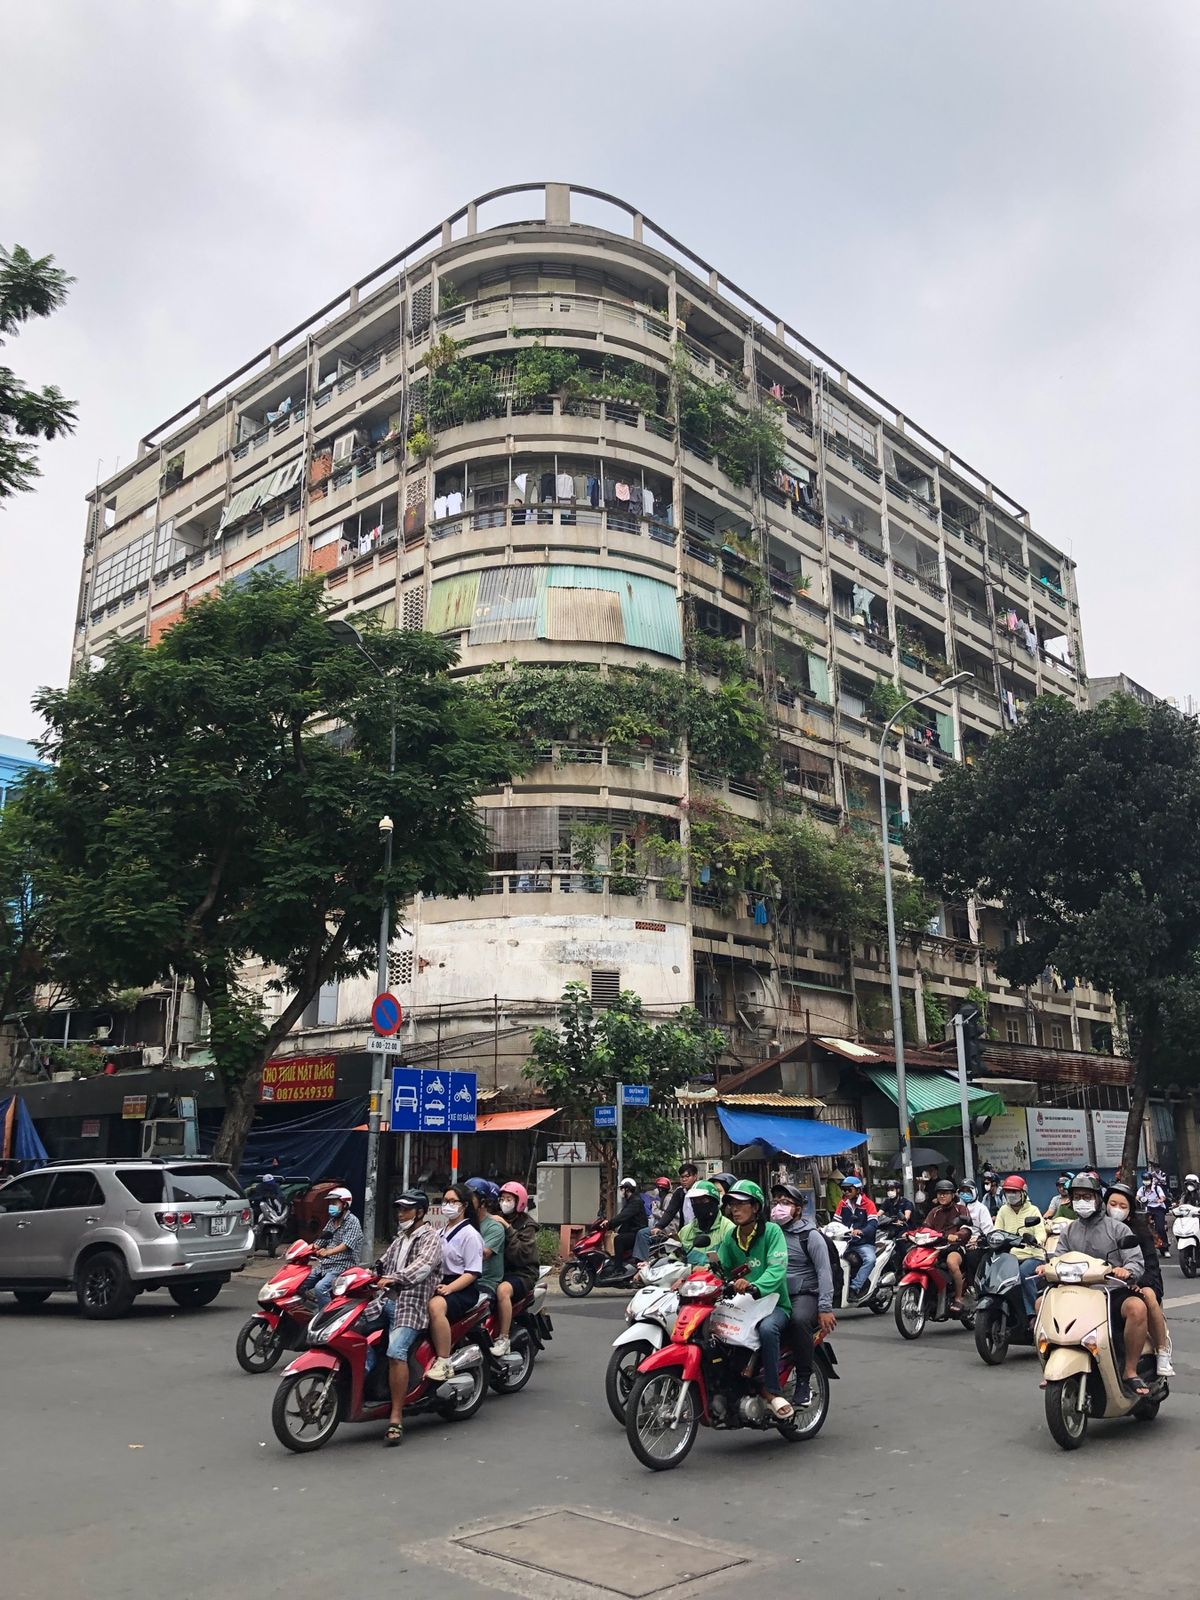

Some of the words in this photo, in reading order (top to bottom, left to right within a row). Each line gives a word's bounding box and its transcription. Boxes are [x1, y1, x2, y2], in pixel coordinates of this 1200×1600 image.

[263, 1067, 277, 1083] CHO
[278, 1062, 296, 1082] THUÊ
[276, 1085, 334, 1100] 0876549339
[450, 1113, 456, 1121] XE
